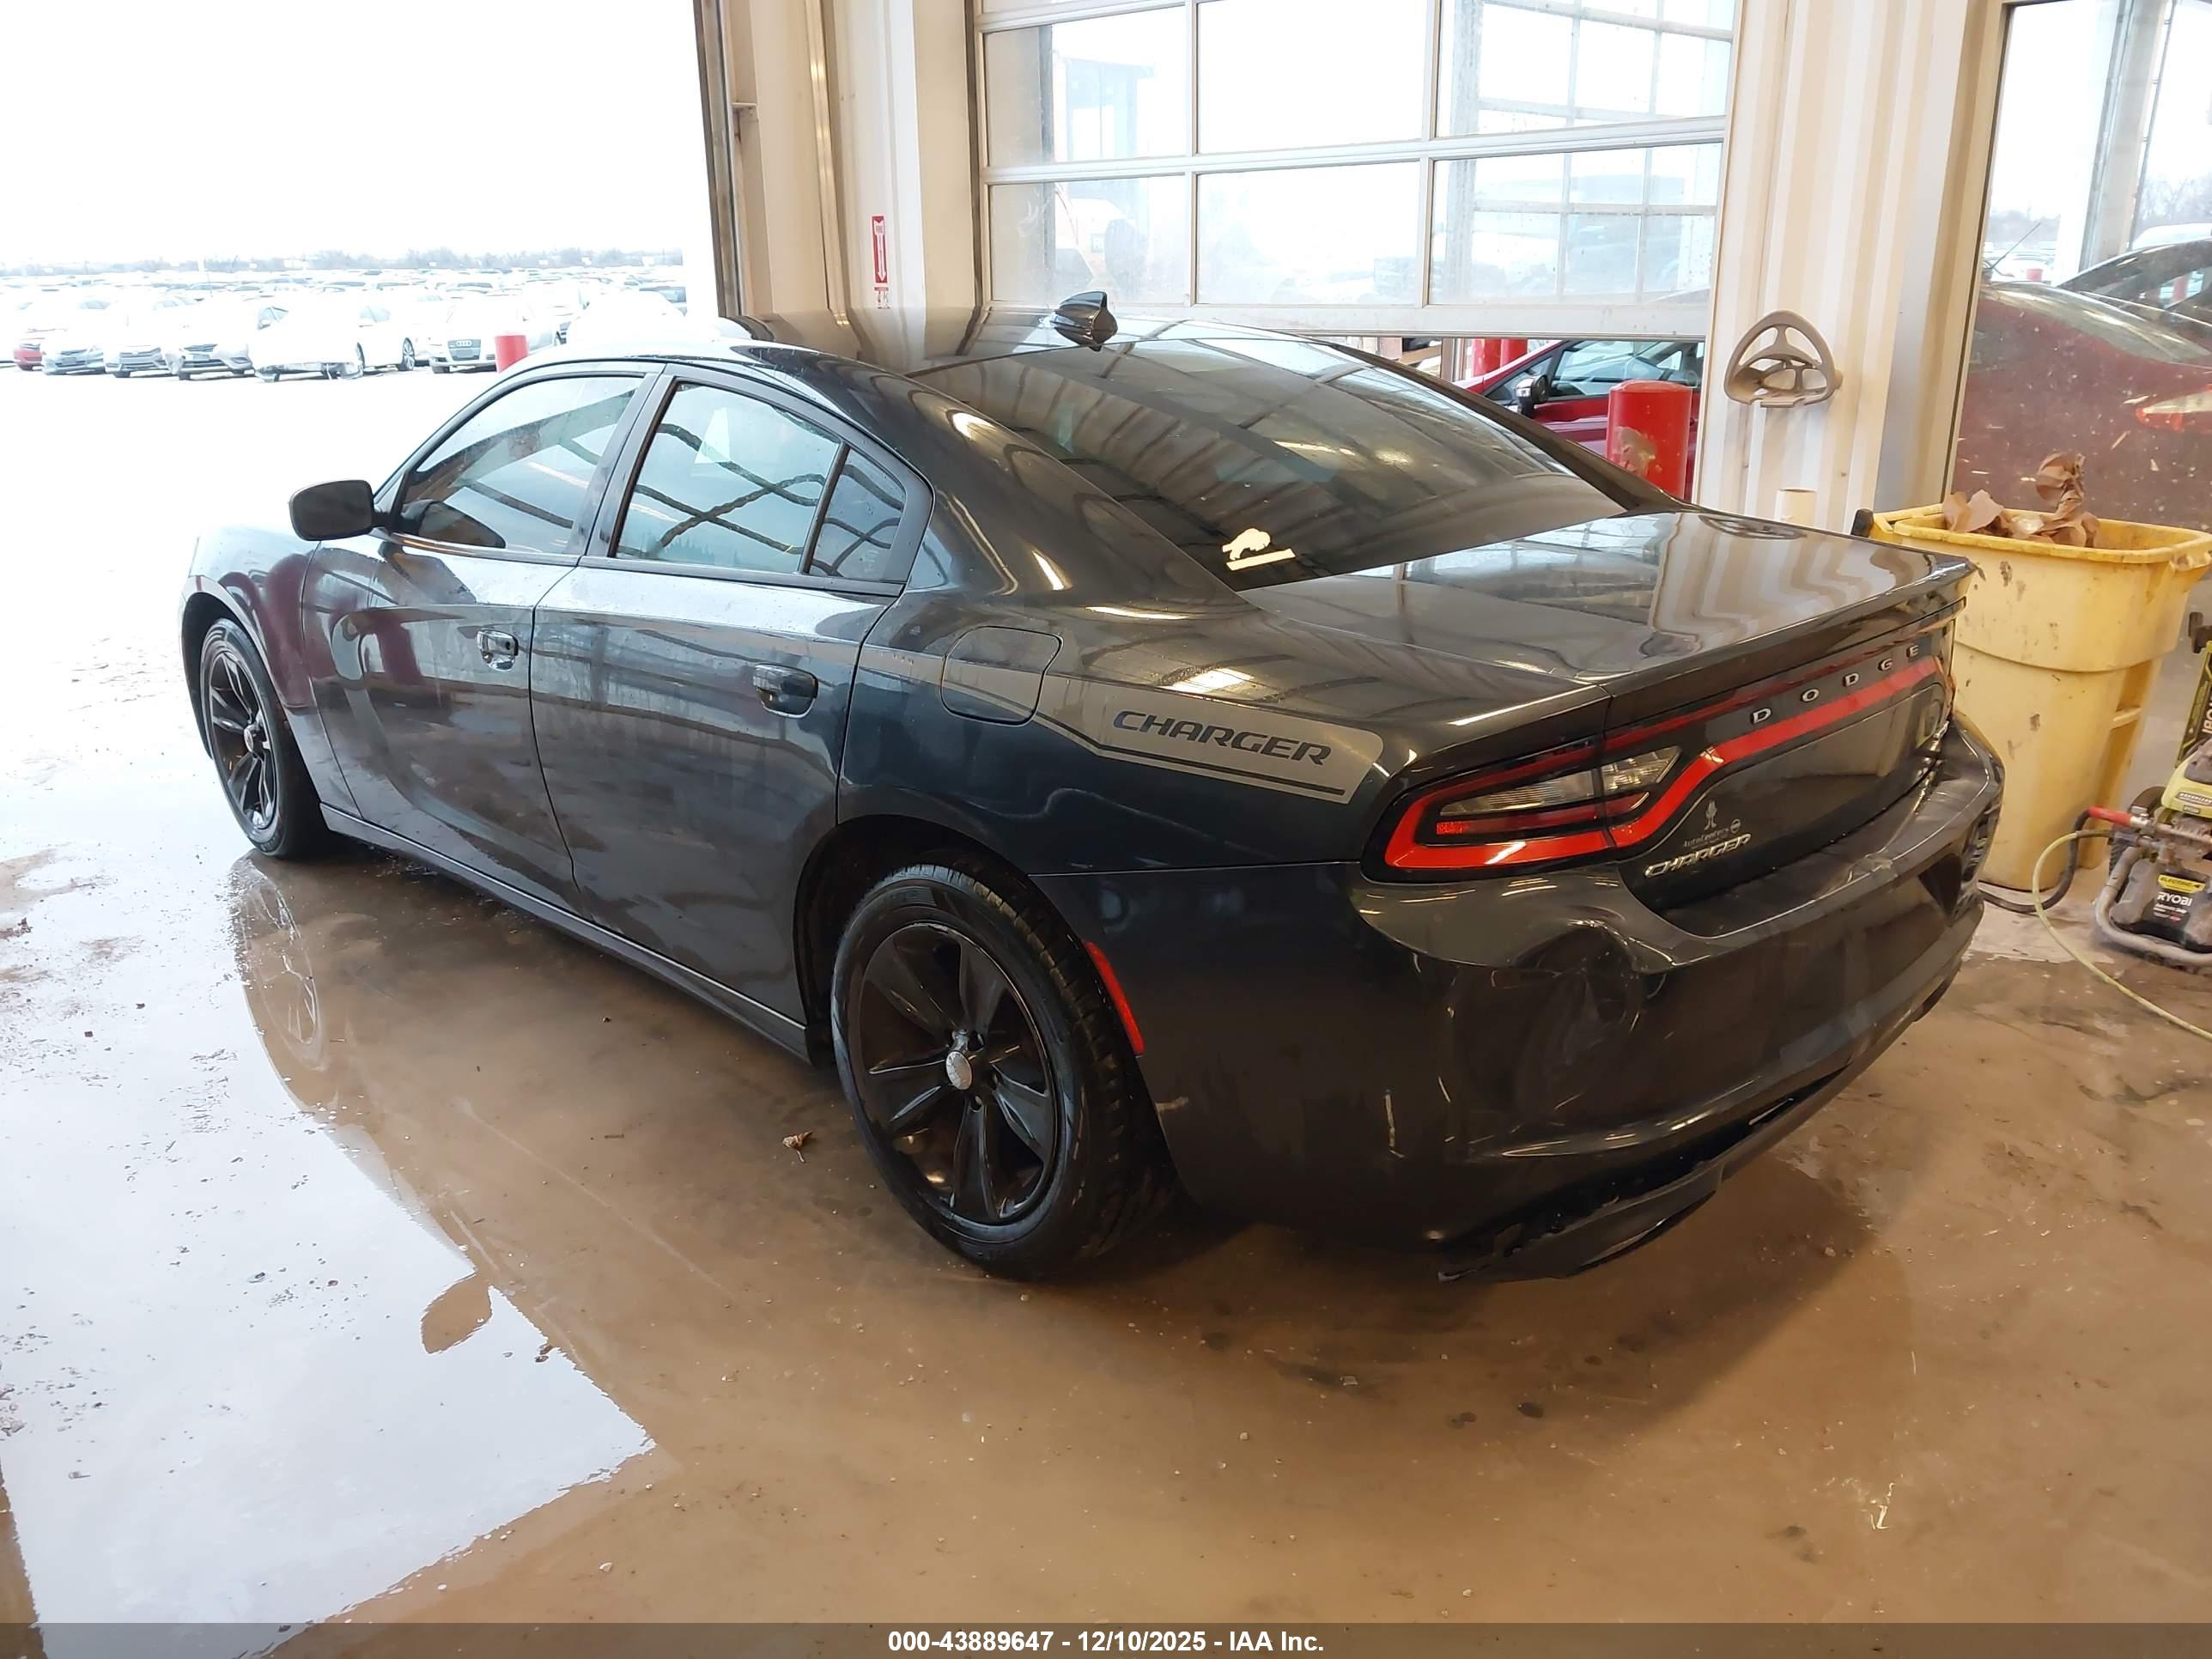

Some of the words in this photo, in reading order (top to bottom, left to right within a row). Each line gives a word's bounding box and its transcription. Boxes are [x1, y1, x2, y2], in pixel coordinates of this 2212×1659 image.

[1751, 644, 1920, 724] DODGE
[1113, 710, 1333, 766] CHARGER
[1644, 833, 1752, 878] CHARGER
[2156, 891, 2193, 907] RYOBI
